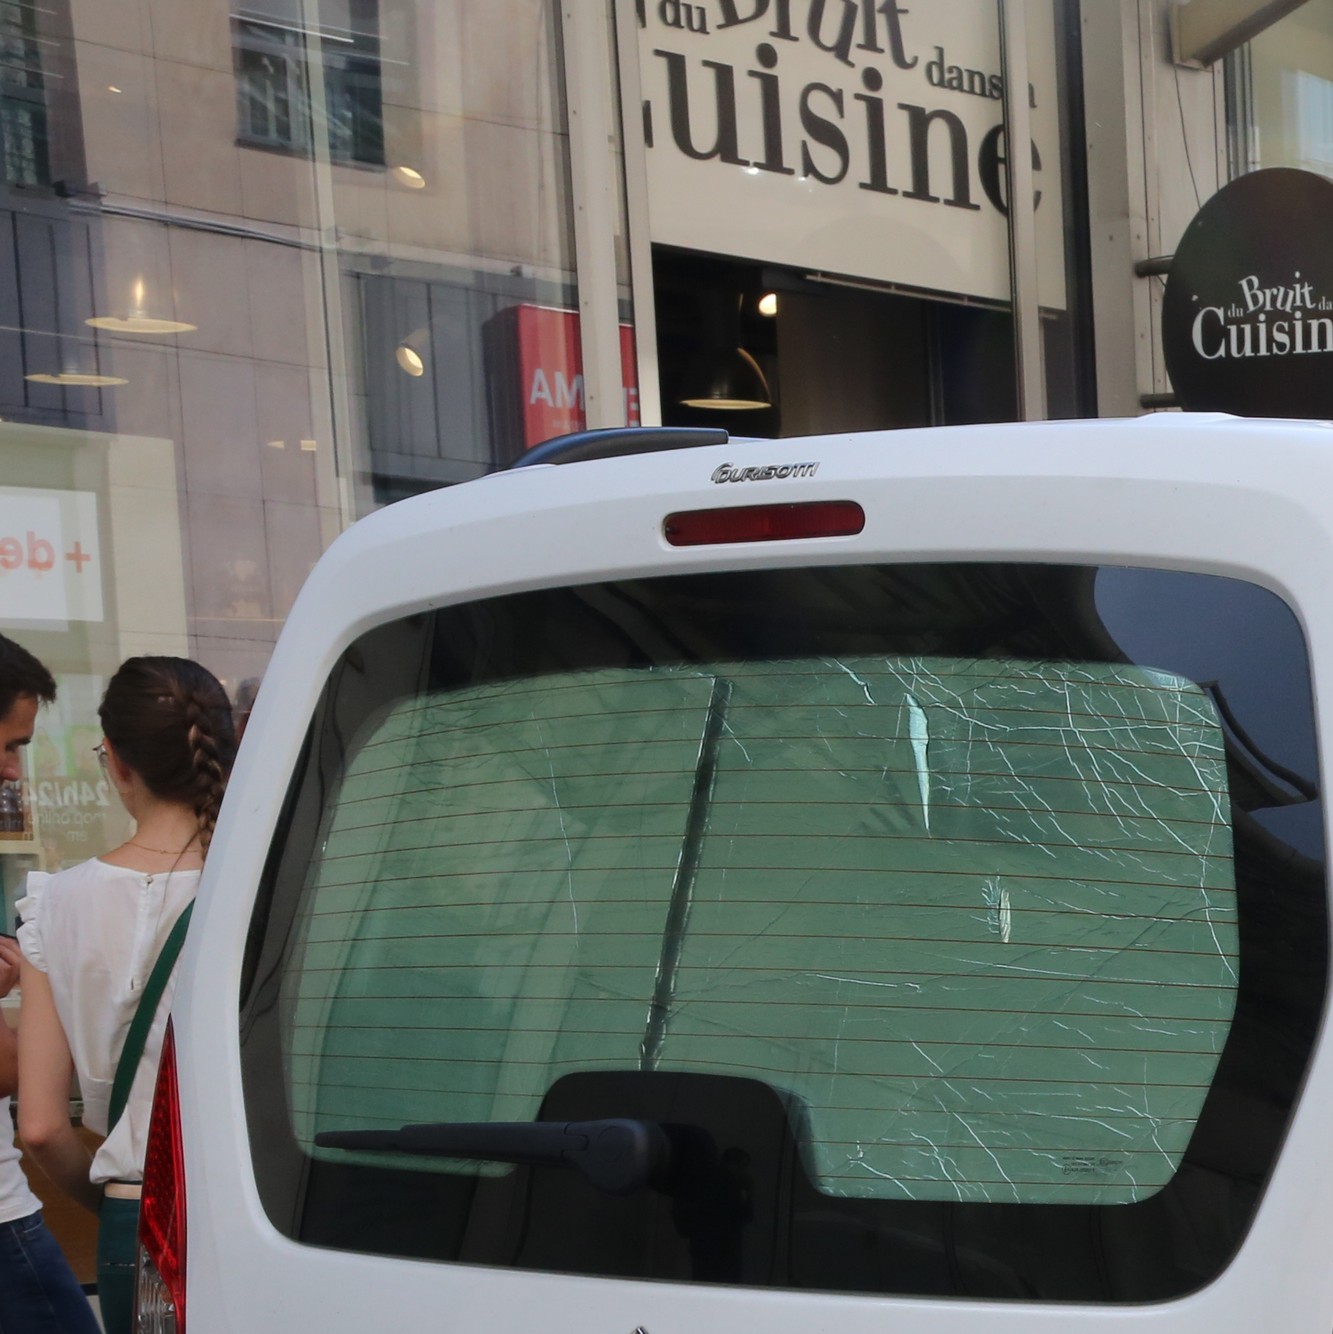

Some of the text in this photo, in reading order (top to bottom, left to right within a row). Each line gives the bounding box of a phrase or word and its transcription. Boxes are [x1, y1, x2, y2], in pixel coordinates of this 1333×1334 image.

[643, 42, 1043, 219] uisine
[1227, 303, 1244, 319] du
[1238, 271, 1316, 314] Bruit
